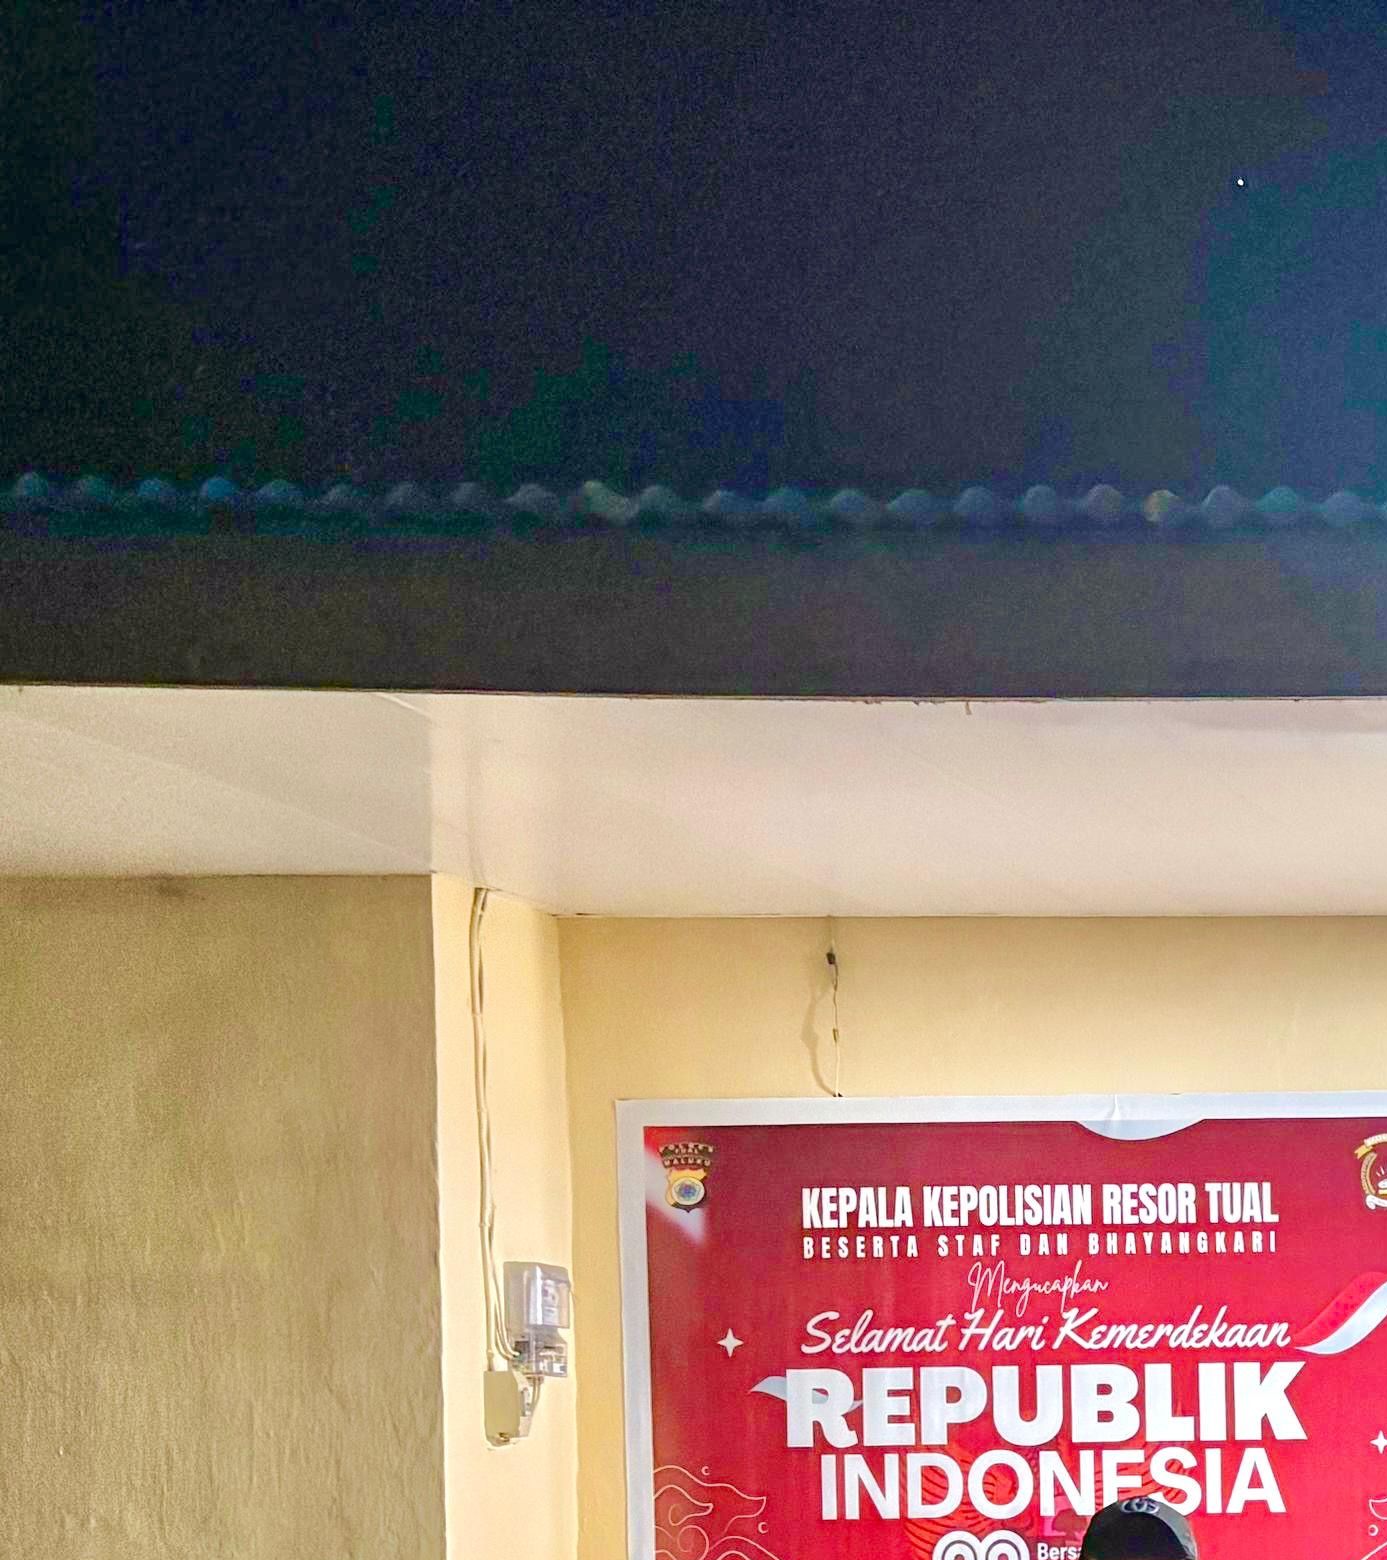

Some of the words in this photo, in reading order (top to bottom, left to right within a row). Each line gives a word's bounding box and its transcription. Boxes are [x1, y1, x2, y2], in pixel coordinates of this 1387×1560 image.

[801, 1185, 914, 1229] KEPALA
[922, 1184, 1093, 1227] KEPOLISIAN
[1102, 1182, 1198, 1225] RESOR
[1204, 1181, 1280, 1224] TUAL
[803, 1234, 919, 1259] BESERTA
[937, 1234, 1001, 1257] STAF
[1019, 1232, 1069, 1256] DAN
[1088, 1230, 1277, 1255] BHAYANGKARI
[967, 1259, 1109, 1317] Mengucapkan
[800, 1309, 957, 1354] Selamat
[957, 1307, 1050, 1352] Hari
[1051, 1304, 1292, 1350] Kemerdekaan
[785, 1360, 1308, 1448] REPUBLIK
[820, 1446, 1287, 1521] INDONESIA
